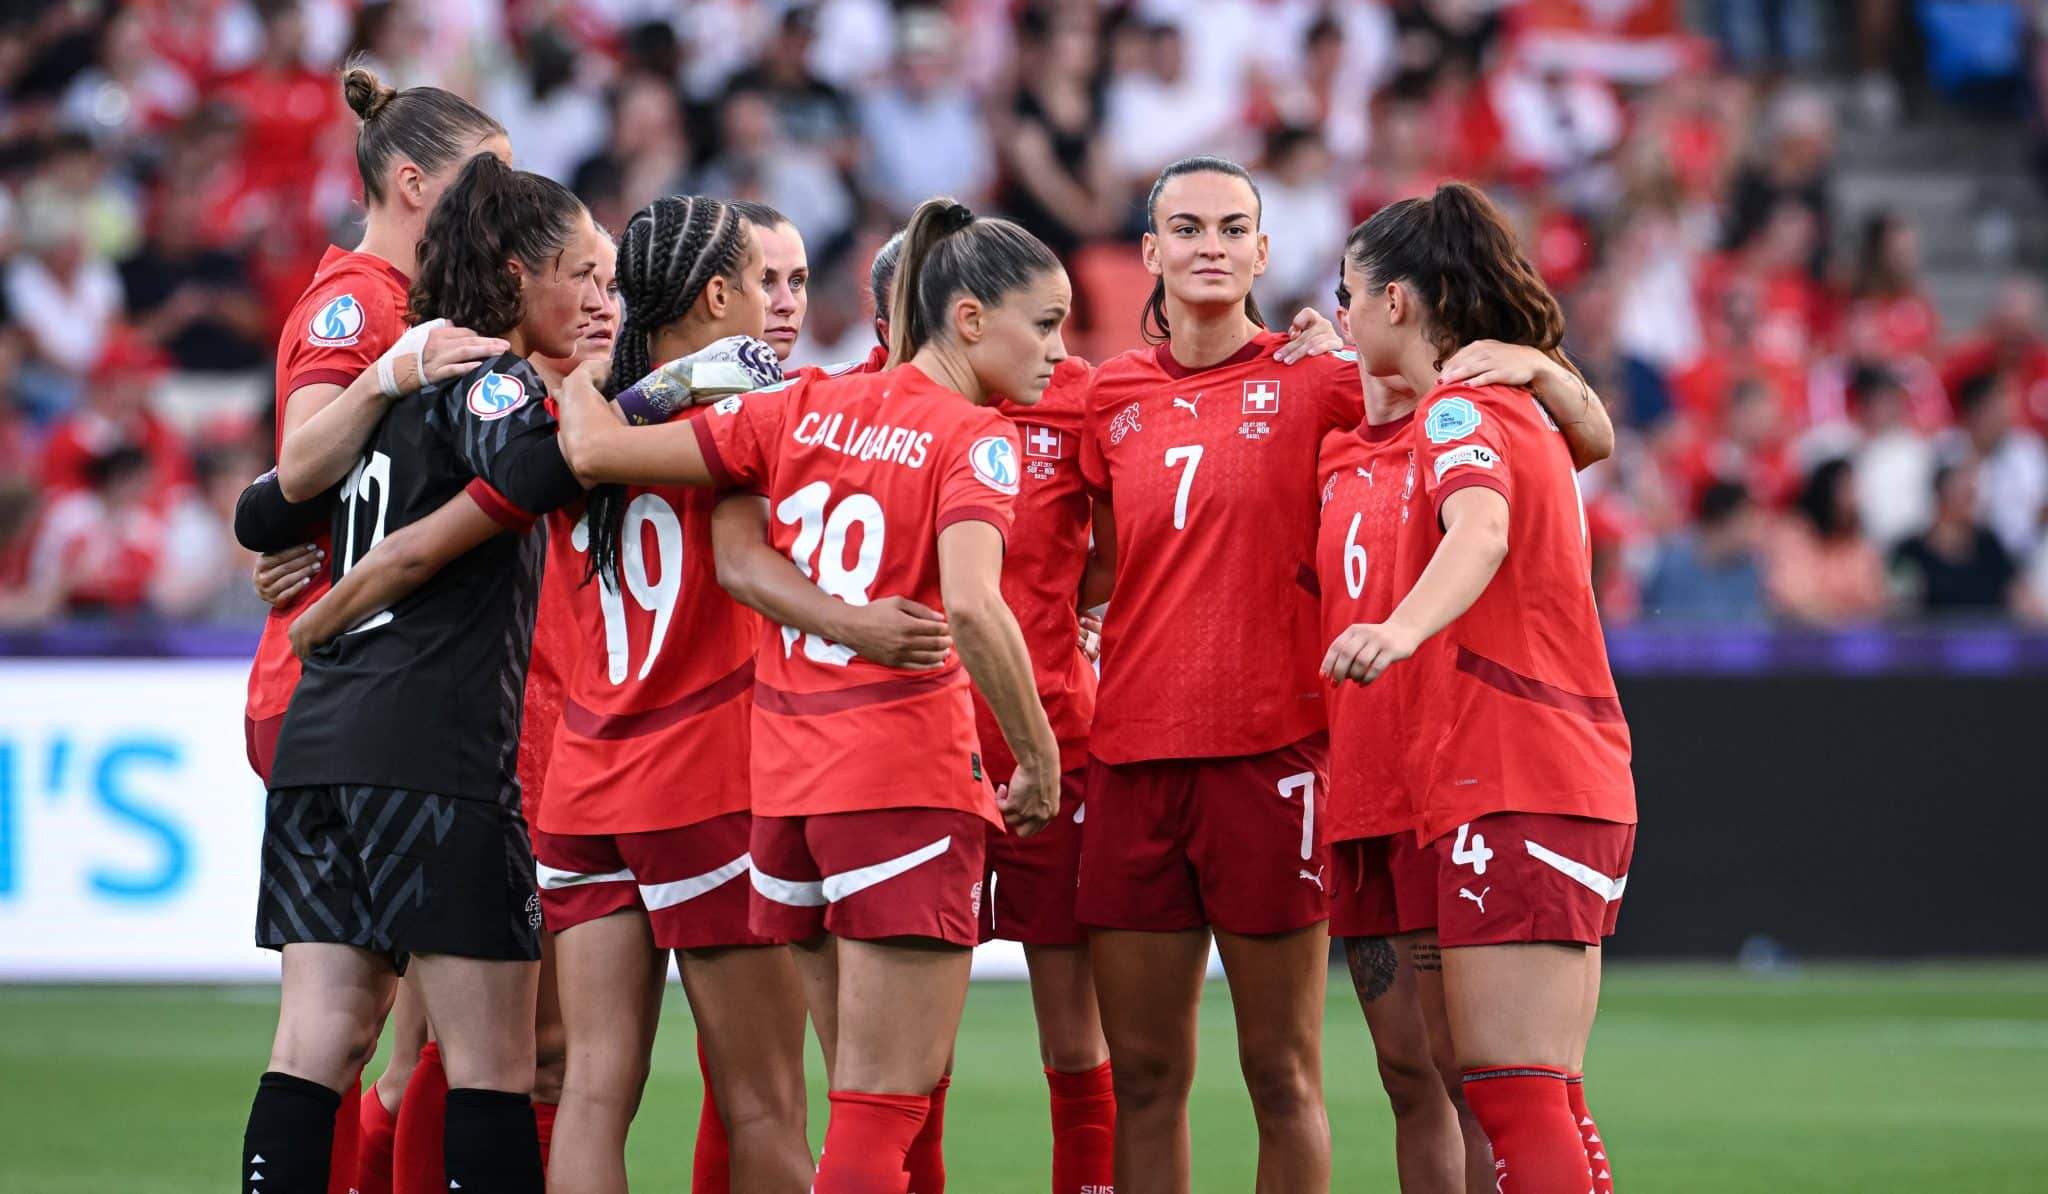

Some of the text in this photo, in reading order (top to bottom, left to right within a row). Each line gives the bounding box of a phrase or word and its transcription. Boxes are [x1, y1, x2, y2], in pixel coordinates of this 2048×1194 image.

[1165, 445, 1204, 531] 7
[571, 493, 683, 686] 19
[777, 481, 885, 667] 18
[1343, 511, 1367, 600] 6
[1277, 771, 1316, 861] 7
[1452, 822, 1494, 875] 4
